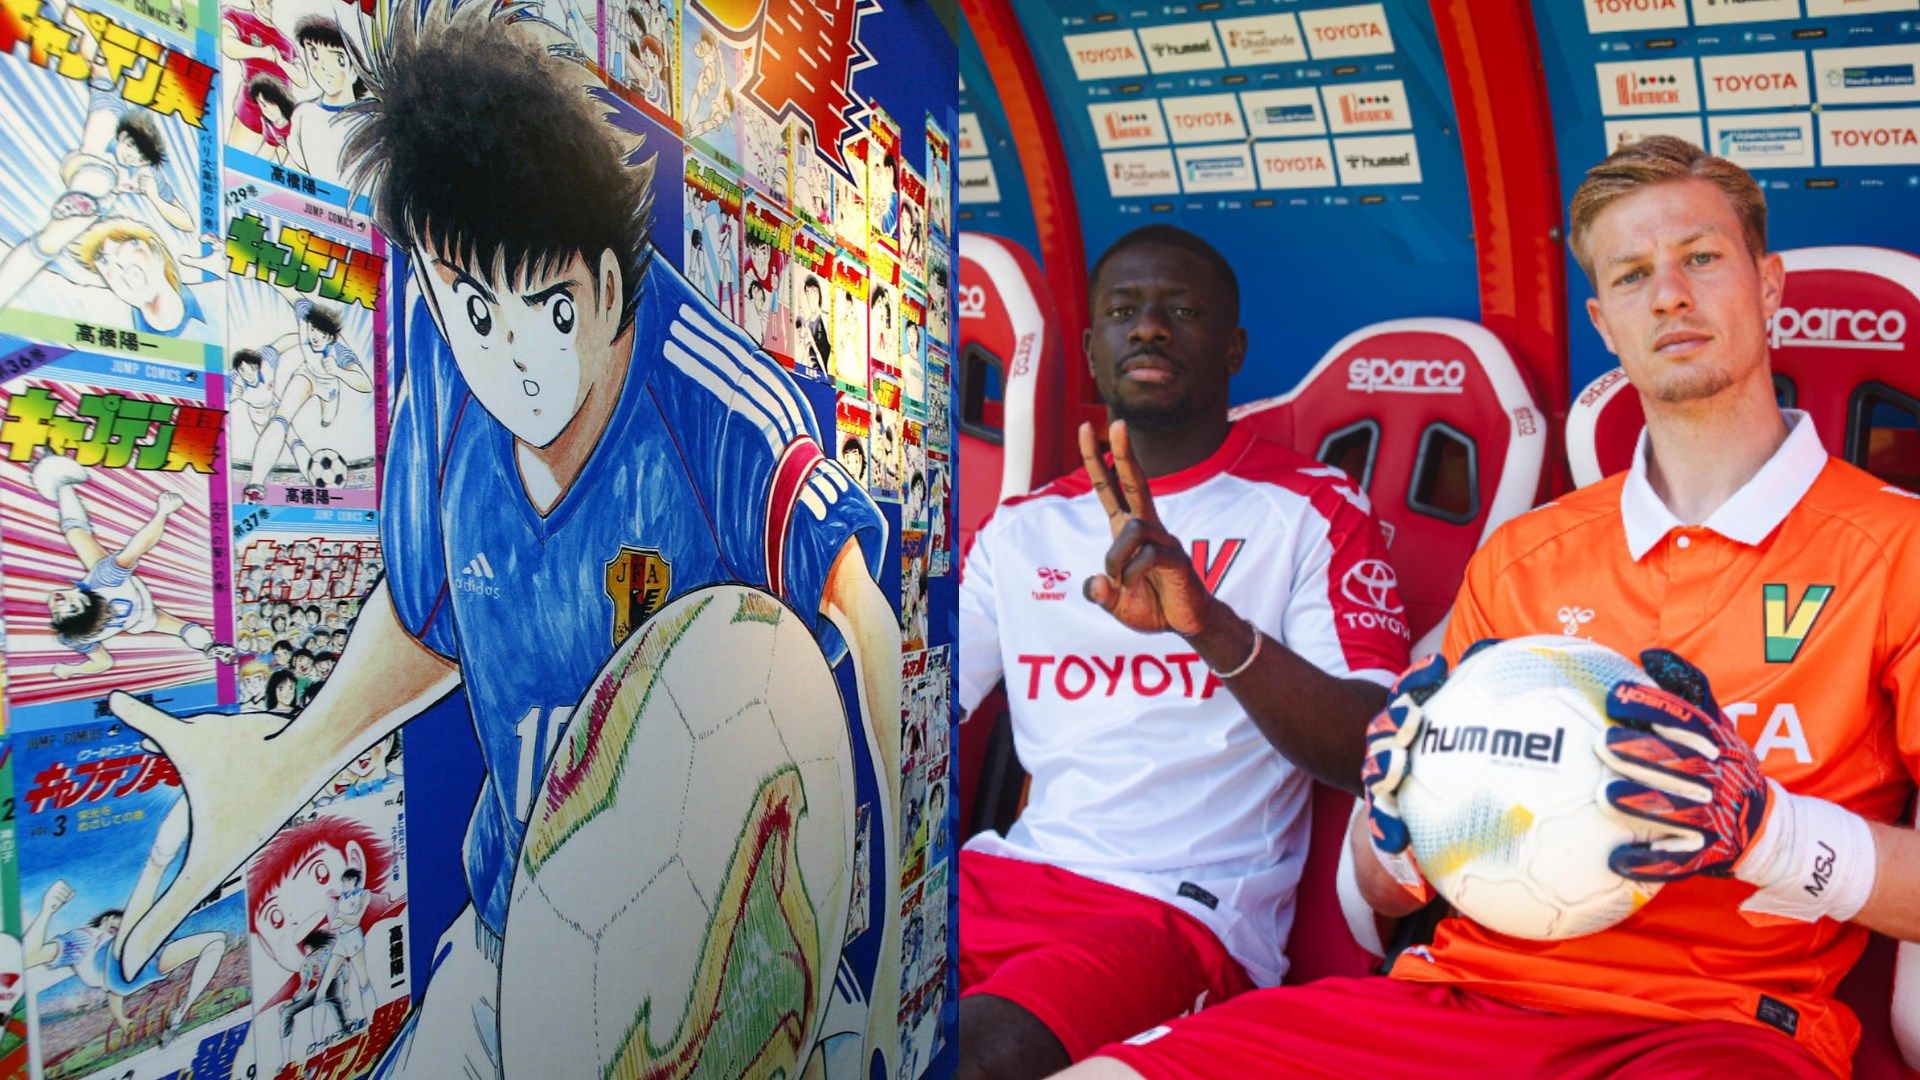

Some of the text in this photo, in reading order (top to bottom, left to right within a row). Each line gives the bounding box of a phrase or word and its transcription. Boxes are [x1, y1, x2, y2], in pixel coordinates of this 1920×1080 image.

[1313, 22, 1382, 42] TOYOTA
[1078, 47, 1136, 64] TOYOTA
[1713, 73, 1798, 93] TOYOTA
[1174, 111, 1234, 129] TOYOTA
[1831, 129, 1918, 147] TOYOTA
[1264, 156, 1326, 173] TOYOTA
[303, 203, 354, 229] JUMP COMICS
[226, 213, 388, 312] キャプテン翼
[75, 323, 158, 351] 高橋陽一
[1766, 307, 1906, 349] parco
[111, 360, 182, 382] JUMP COMICS
[1348, 357, 1465, 393] sparco
[0, 387, 228, 474] キャプテン翼
[455, 578, 500, 599] adidas
[1762, 584, 1835, 663] V
[1421, 721, 1565, 763] hummel
[53, 815, 67, 837] 3
[1804, 840, 1836, 897] MSJ
